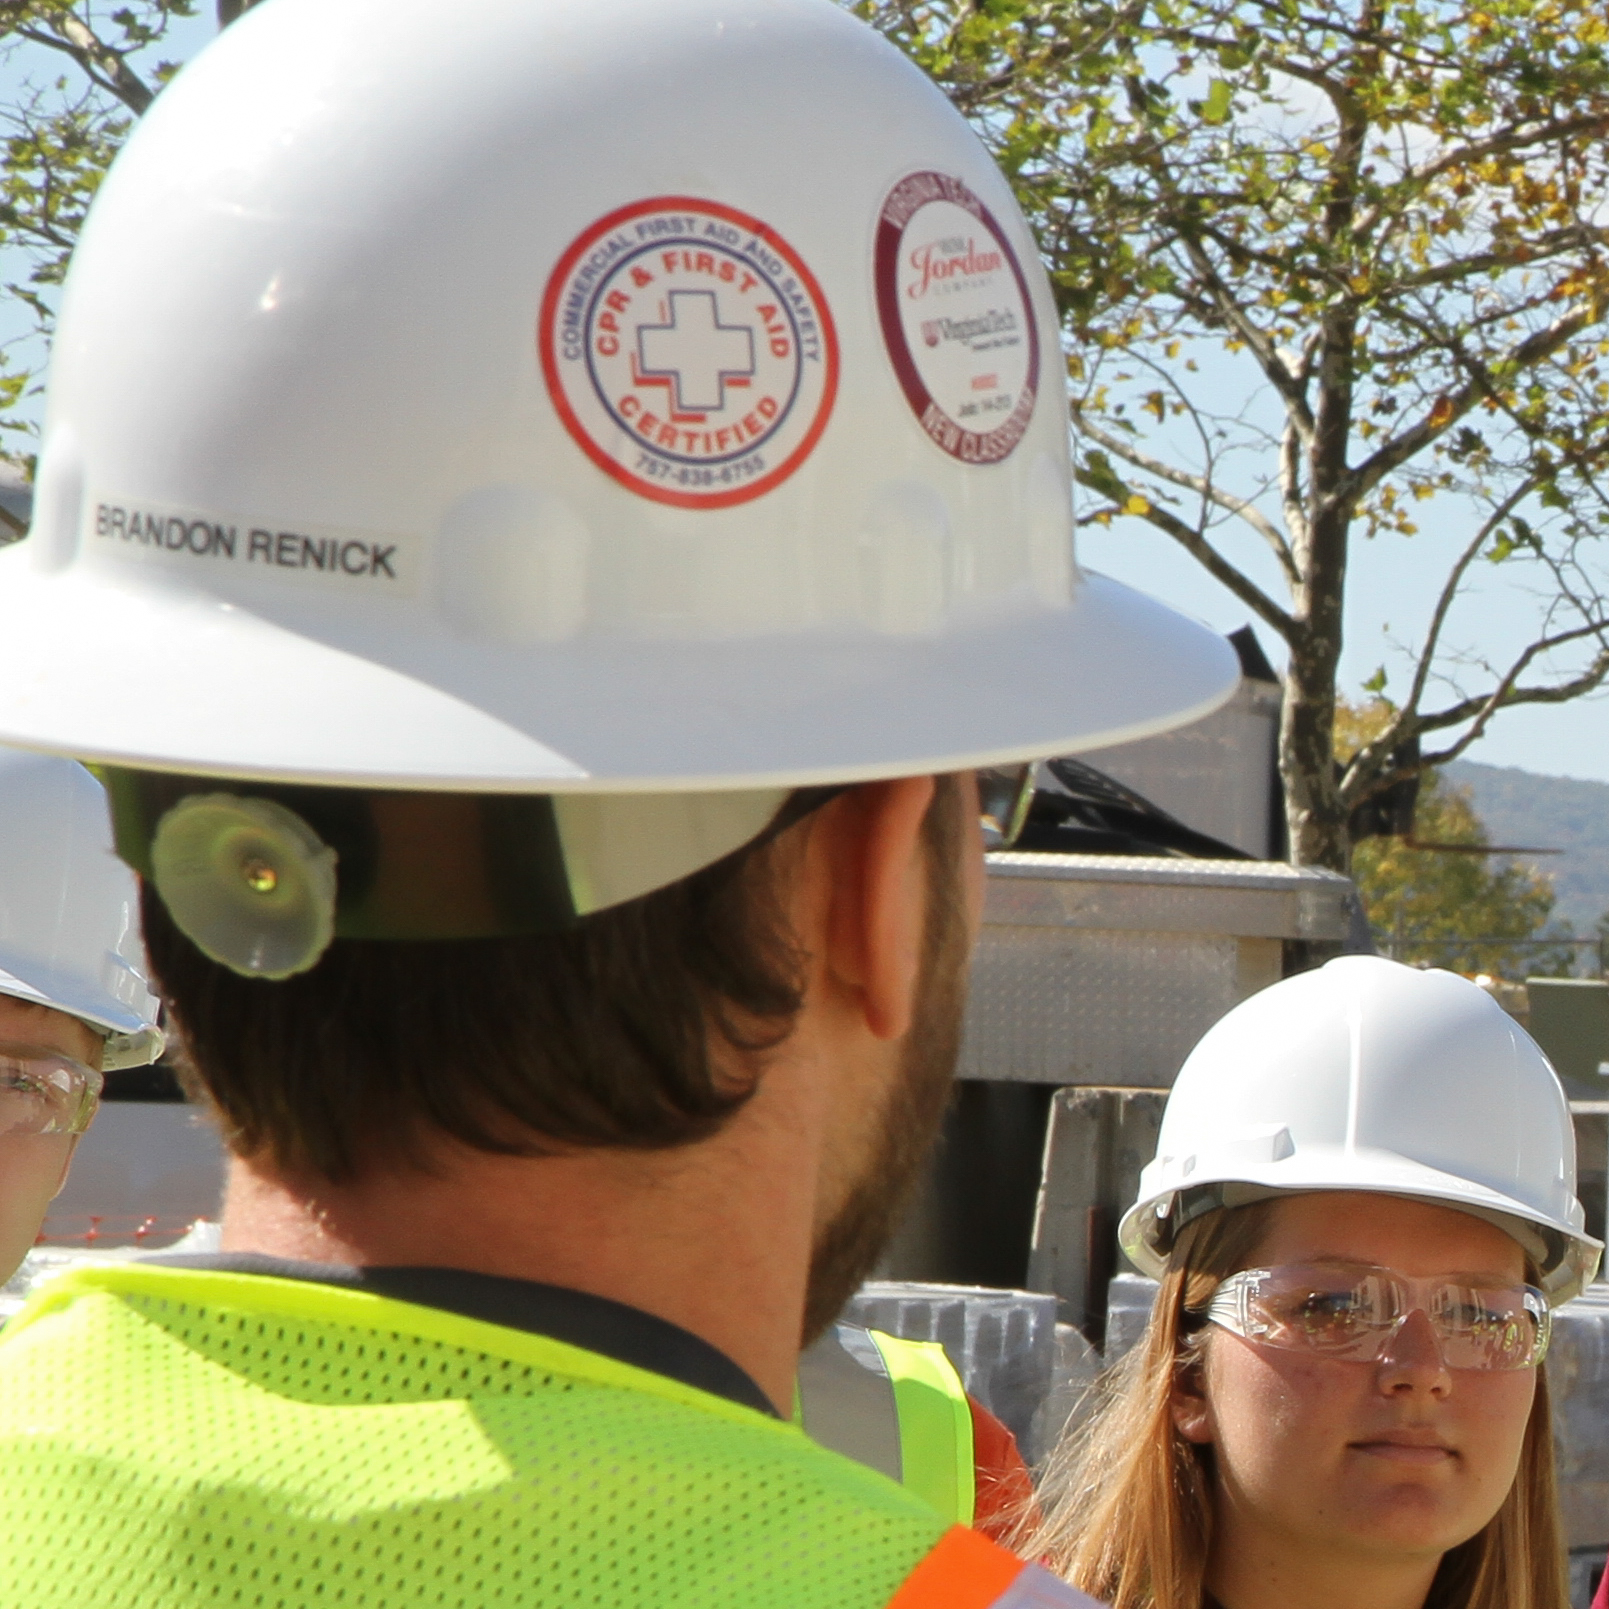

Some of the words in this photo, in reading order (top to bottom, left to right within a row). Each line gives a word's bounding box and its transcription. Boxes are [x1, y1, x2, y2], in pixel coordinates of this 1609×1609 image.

[561, 231, 634, 361] COMMERCIAL
[634, 216, 696, 241] FIRST
[703, 222, 740, 246] AID
[745, 238, 783, 276] AND
[781, 276, 820, 363] SAFETY
[597, 288, 632, 357] CPR
[629, 263, 655, 289] &
[660, 251, 760, 295] FIRST
[755, 302, 791, 358] AID
[618, 394, 779, 454] CERTIFIED
[96, 503, 236, 560] BRANDON
[247, 528, 397, 580] RENICK
